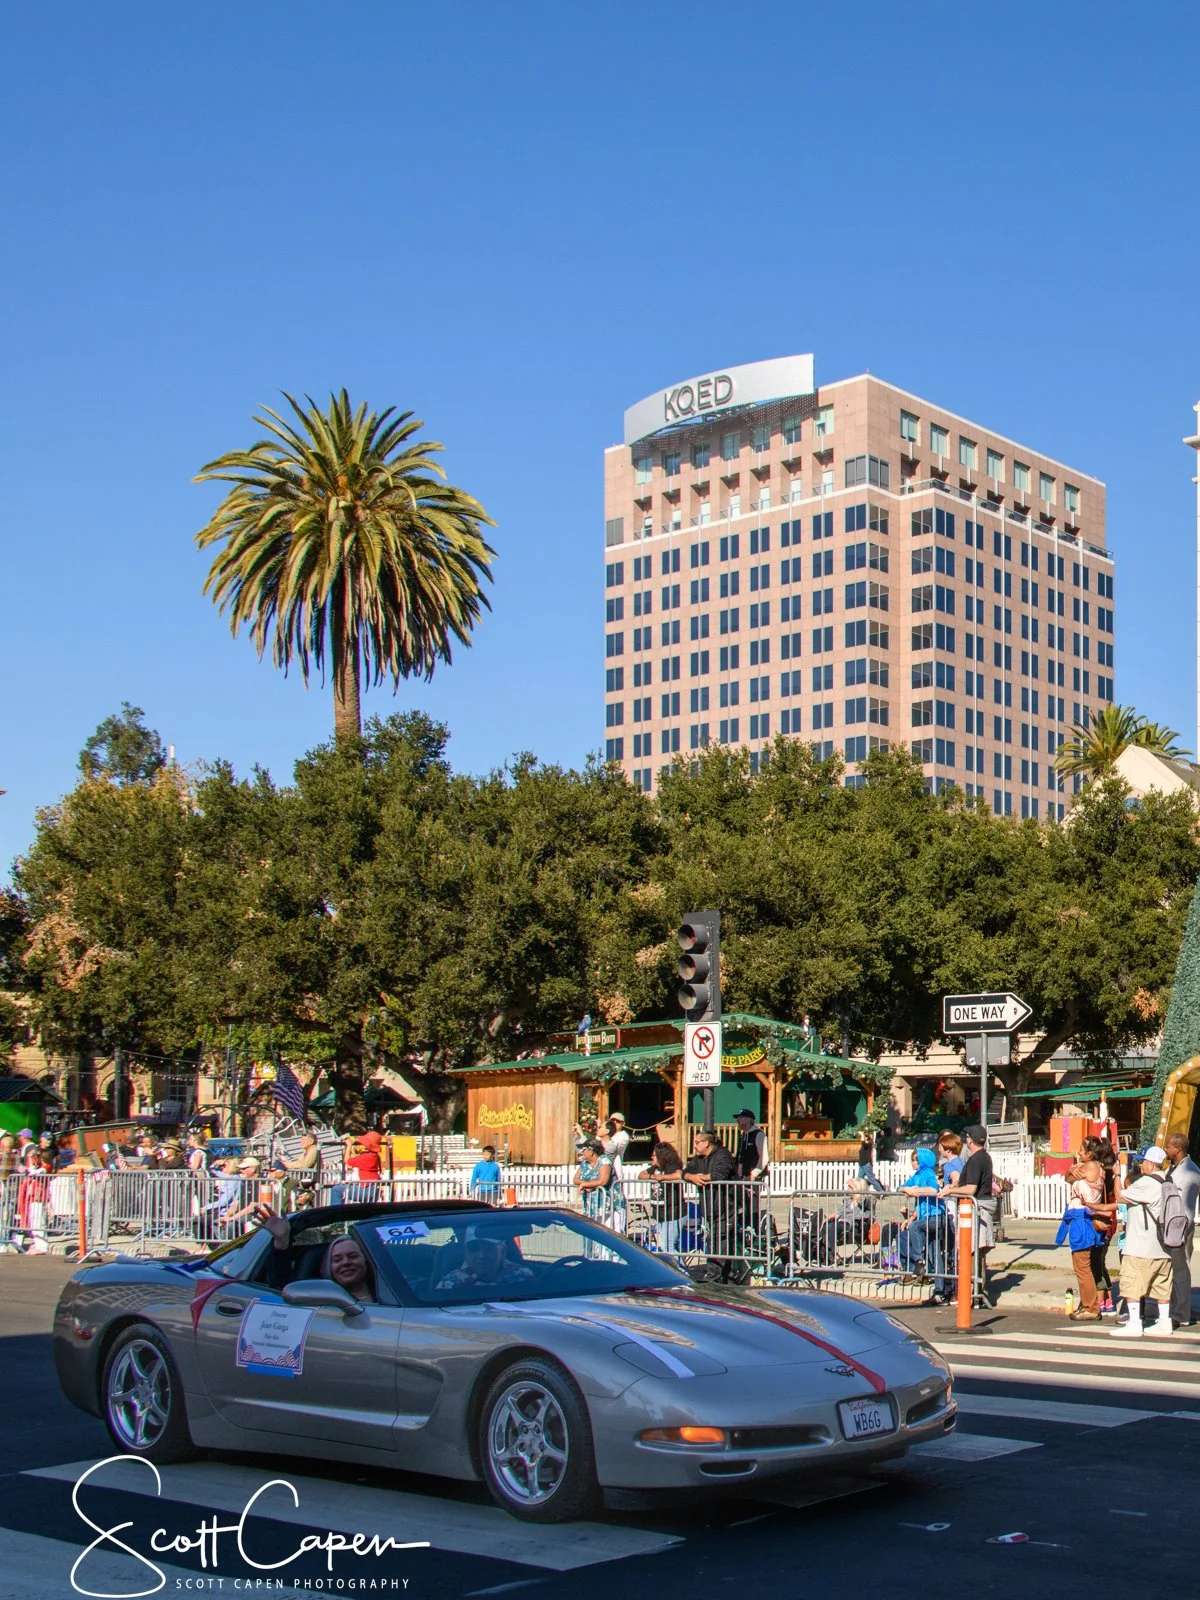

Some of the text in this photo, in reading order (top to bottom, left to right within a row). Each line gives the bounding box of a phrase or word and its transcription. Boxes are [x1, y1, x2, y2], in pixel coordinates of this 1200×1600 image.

[664, 374, 735, 422] KQED
[954, 1006, 1005, 1020] ONE WAY
[721, 1046, 764, 1065] HE PARK
[697, 1061, 709, 1071] ON
[694, 1072, 711, 1082] RED
[388, 1226, 417, 1237] 64
[853, 1410, 881, 1433] WB6G
